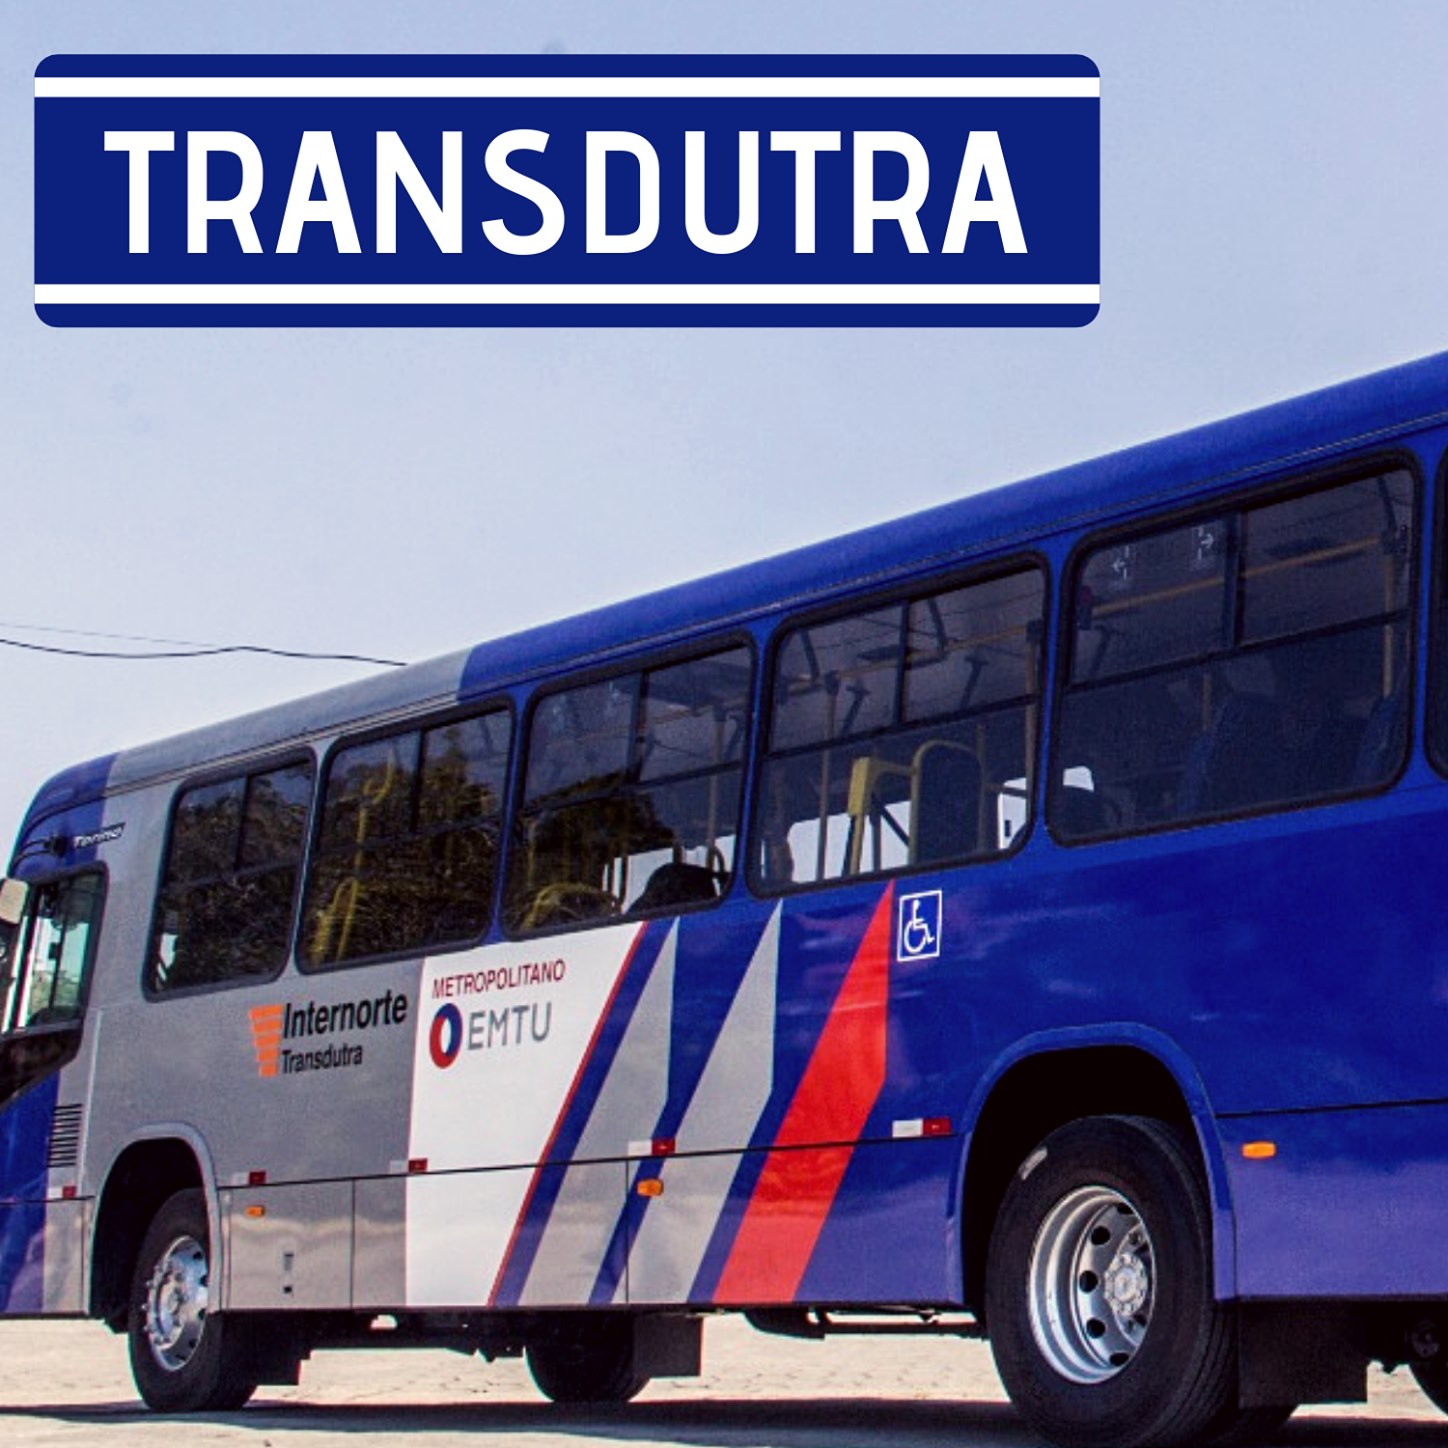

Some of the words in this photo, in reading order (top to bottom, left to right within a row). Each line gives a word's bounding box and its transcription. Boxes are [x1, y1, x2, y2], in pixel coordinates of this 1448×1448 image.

[431, 959, 566, 998] METROPOLITANO
[283, 989, 409, 1039] Internorte
[468, 1002, 552, 1050] EMTU
[282, 1044, 363, 1074] Transdutra
